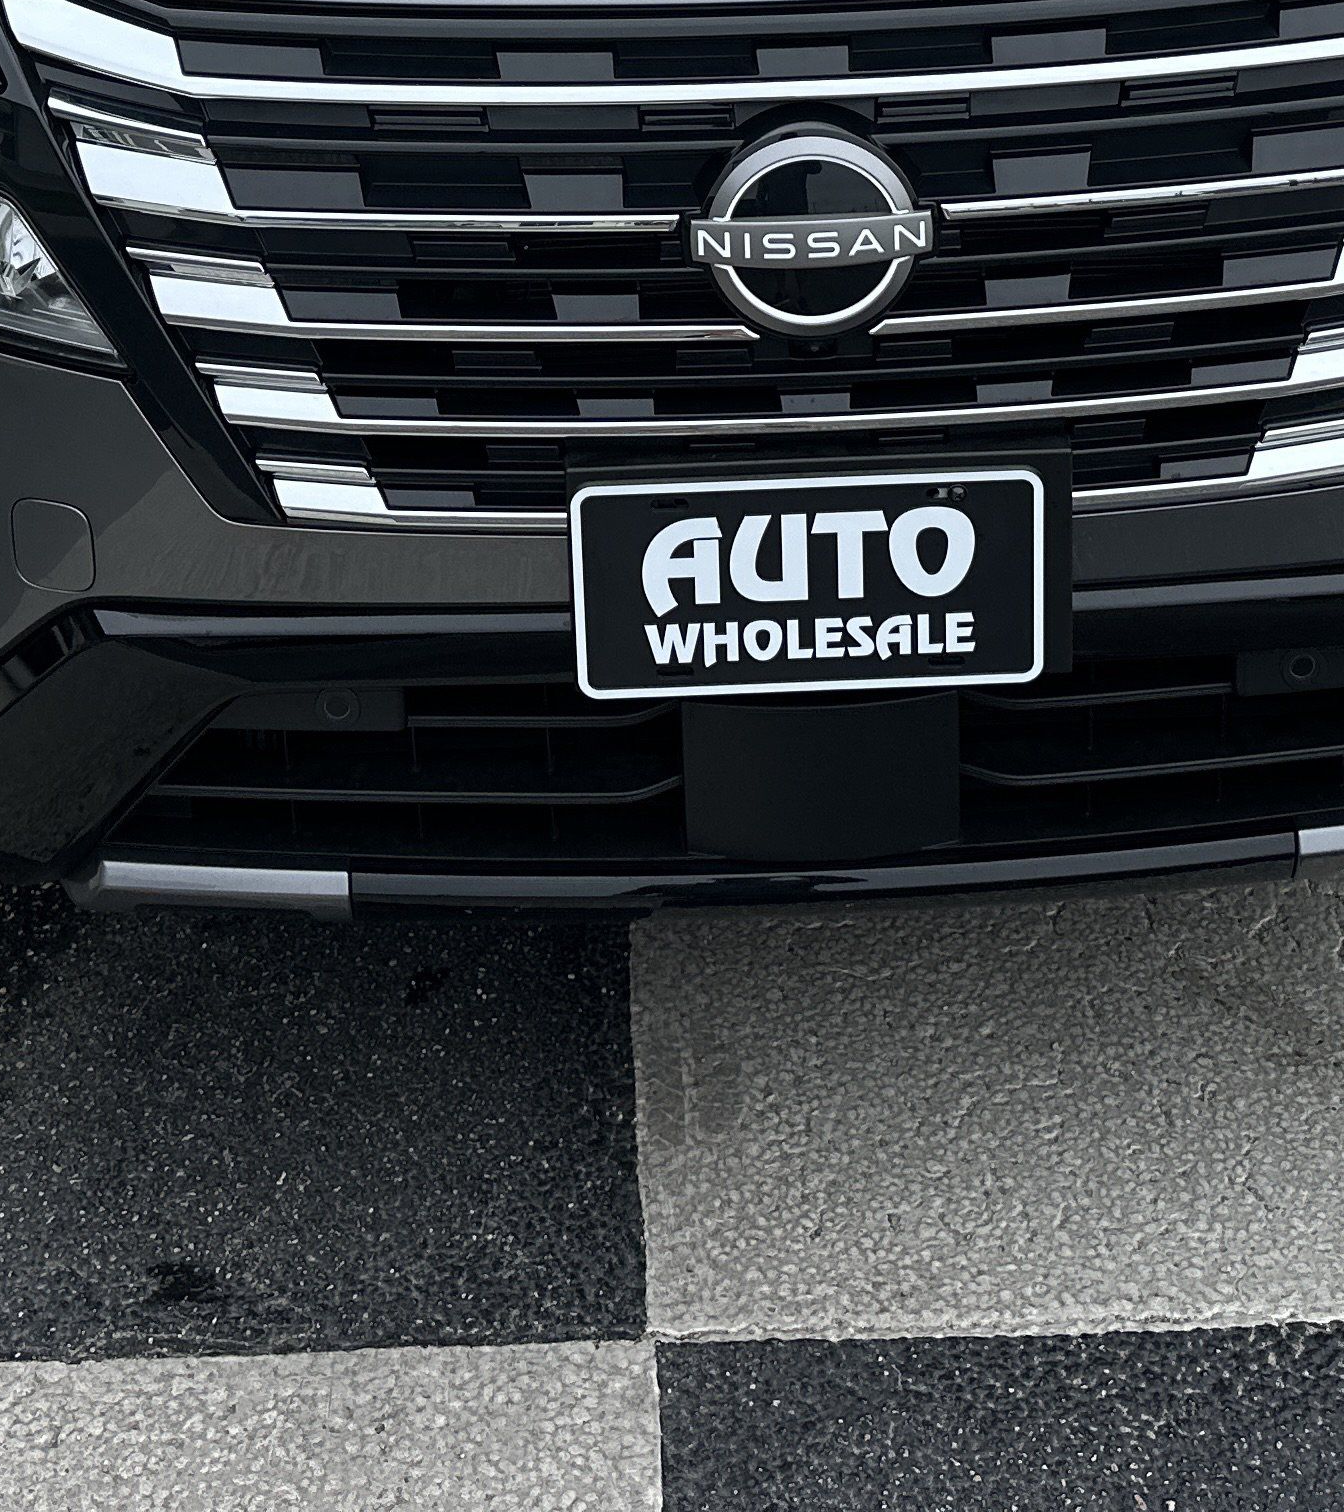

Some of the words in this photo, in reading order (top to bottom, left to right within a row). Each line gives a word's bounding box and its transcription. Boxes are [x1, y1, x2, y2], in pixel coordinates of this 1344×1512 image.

[697, 221, 927, 260] NISSAN
[642, 506, 976, 618] AUTO
[644, 612, 977, 668] WHOLESALE
